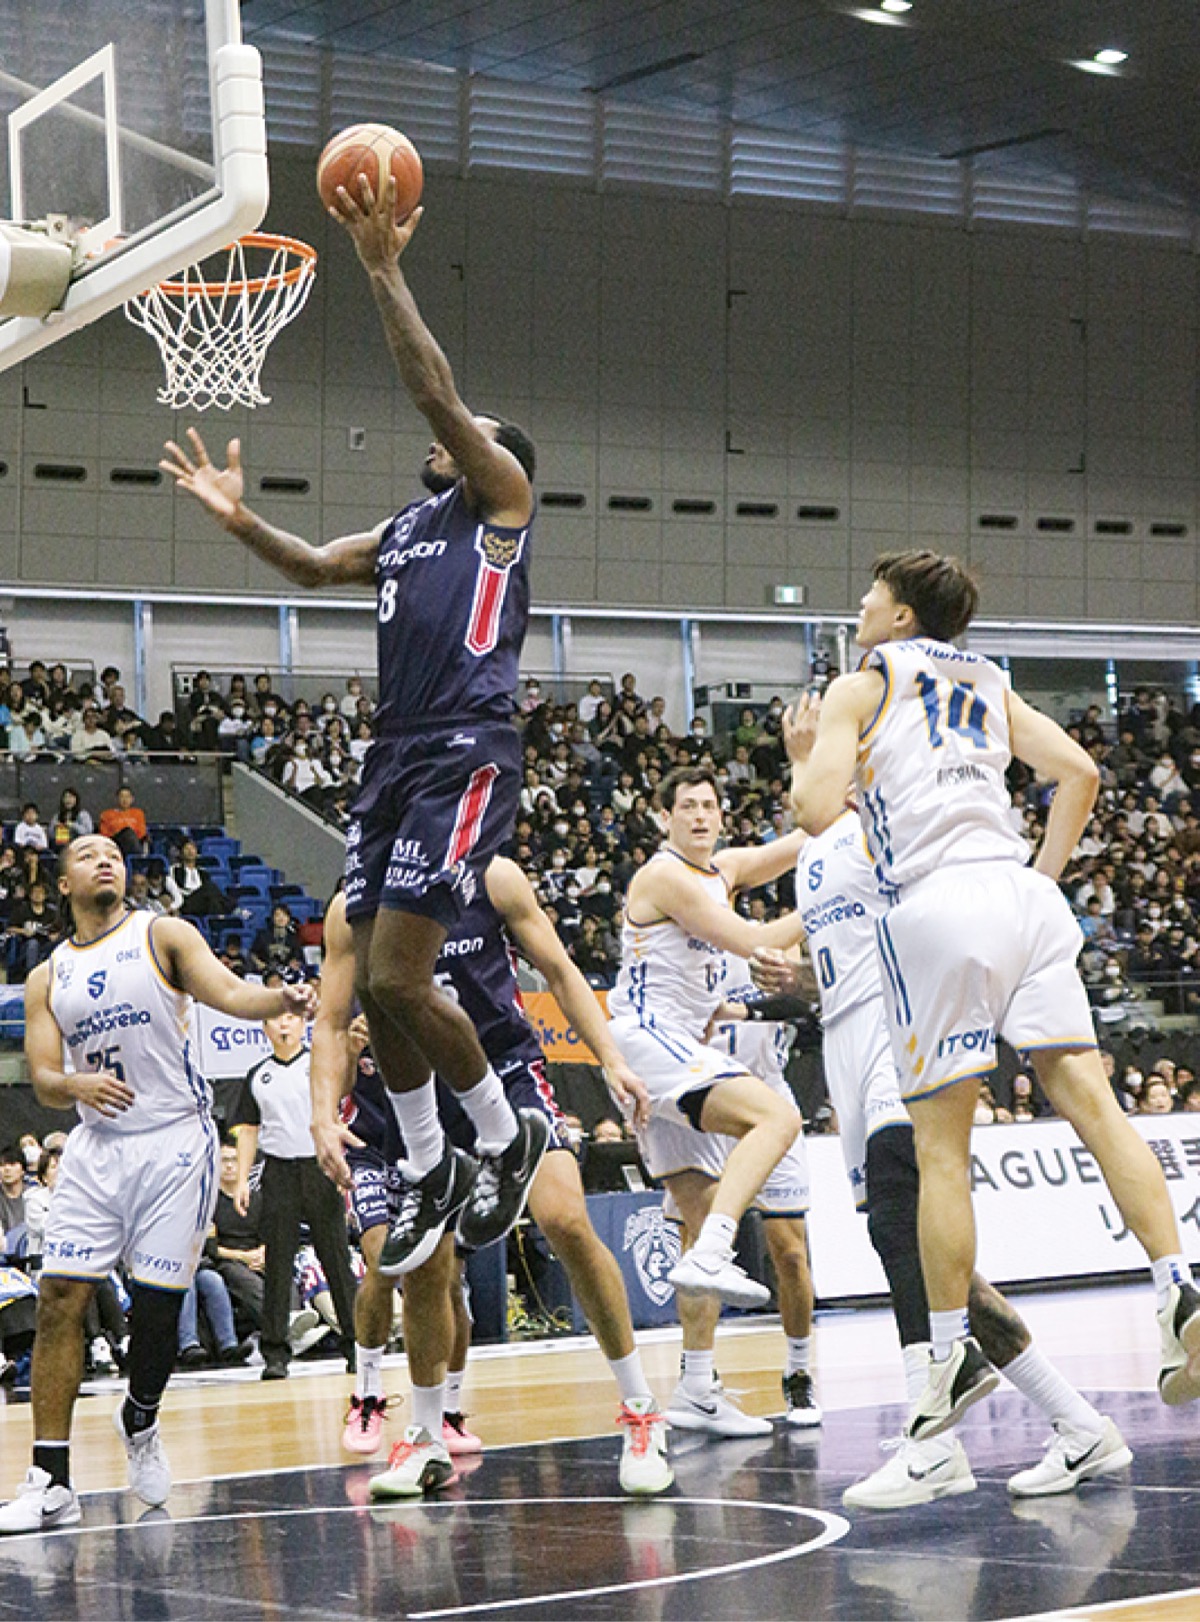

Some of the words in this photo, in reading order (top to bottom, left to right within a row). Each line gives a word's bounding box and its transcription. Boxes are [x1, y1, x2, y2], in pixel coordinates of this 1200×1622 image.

[378, 578, 399, 623] 8
[914, 670, 990, 751] 14
[808, 858, 824, 891] S
[87, 969, 107, 1000] S
[817, 946, 837, 990] 0
[718, 1024, 737, 1056] 7
